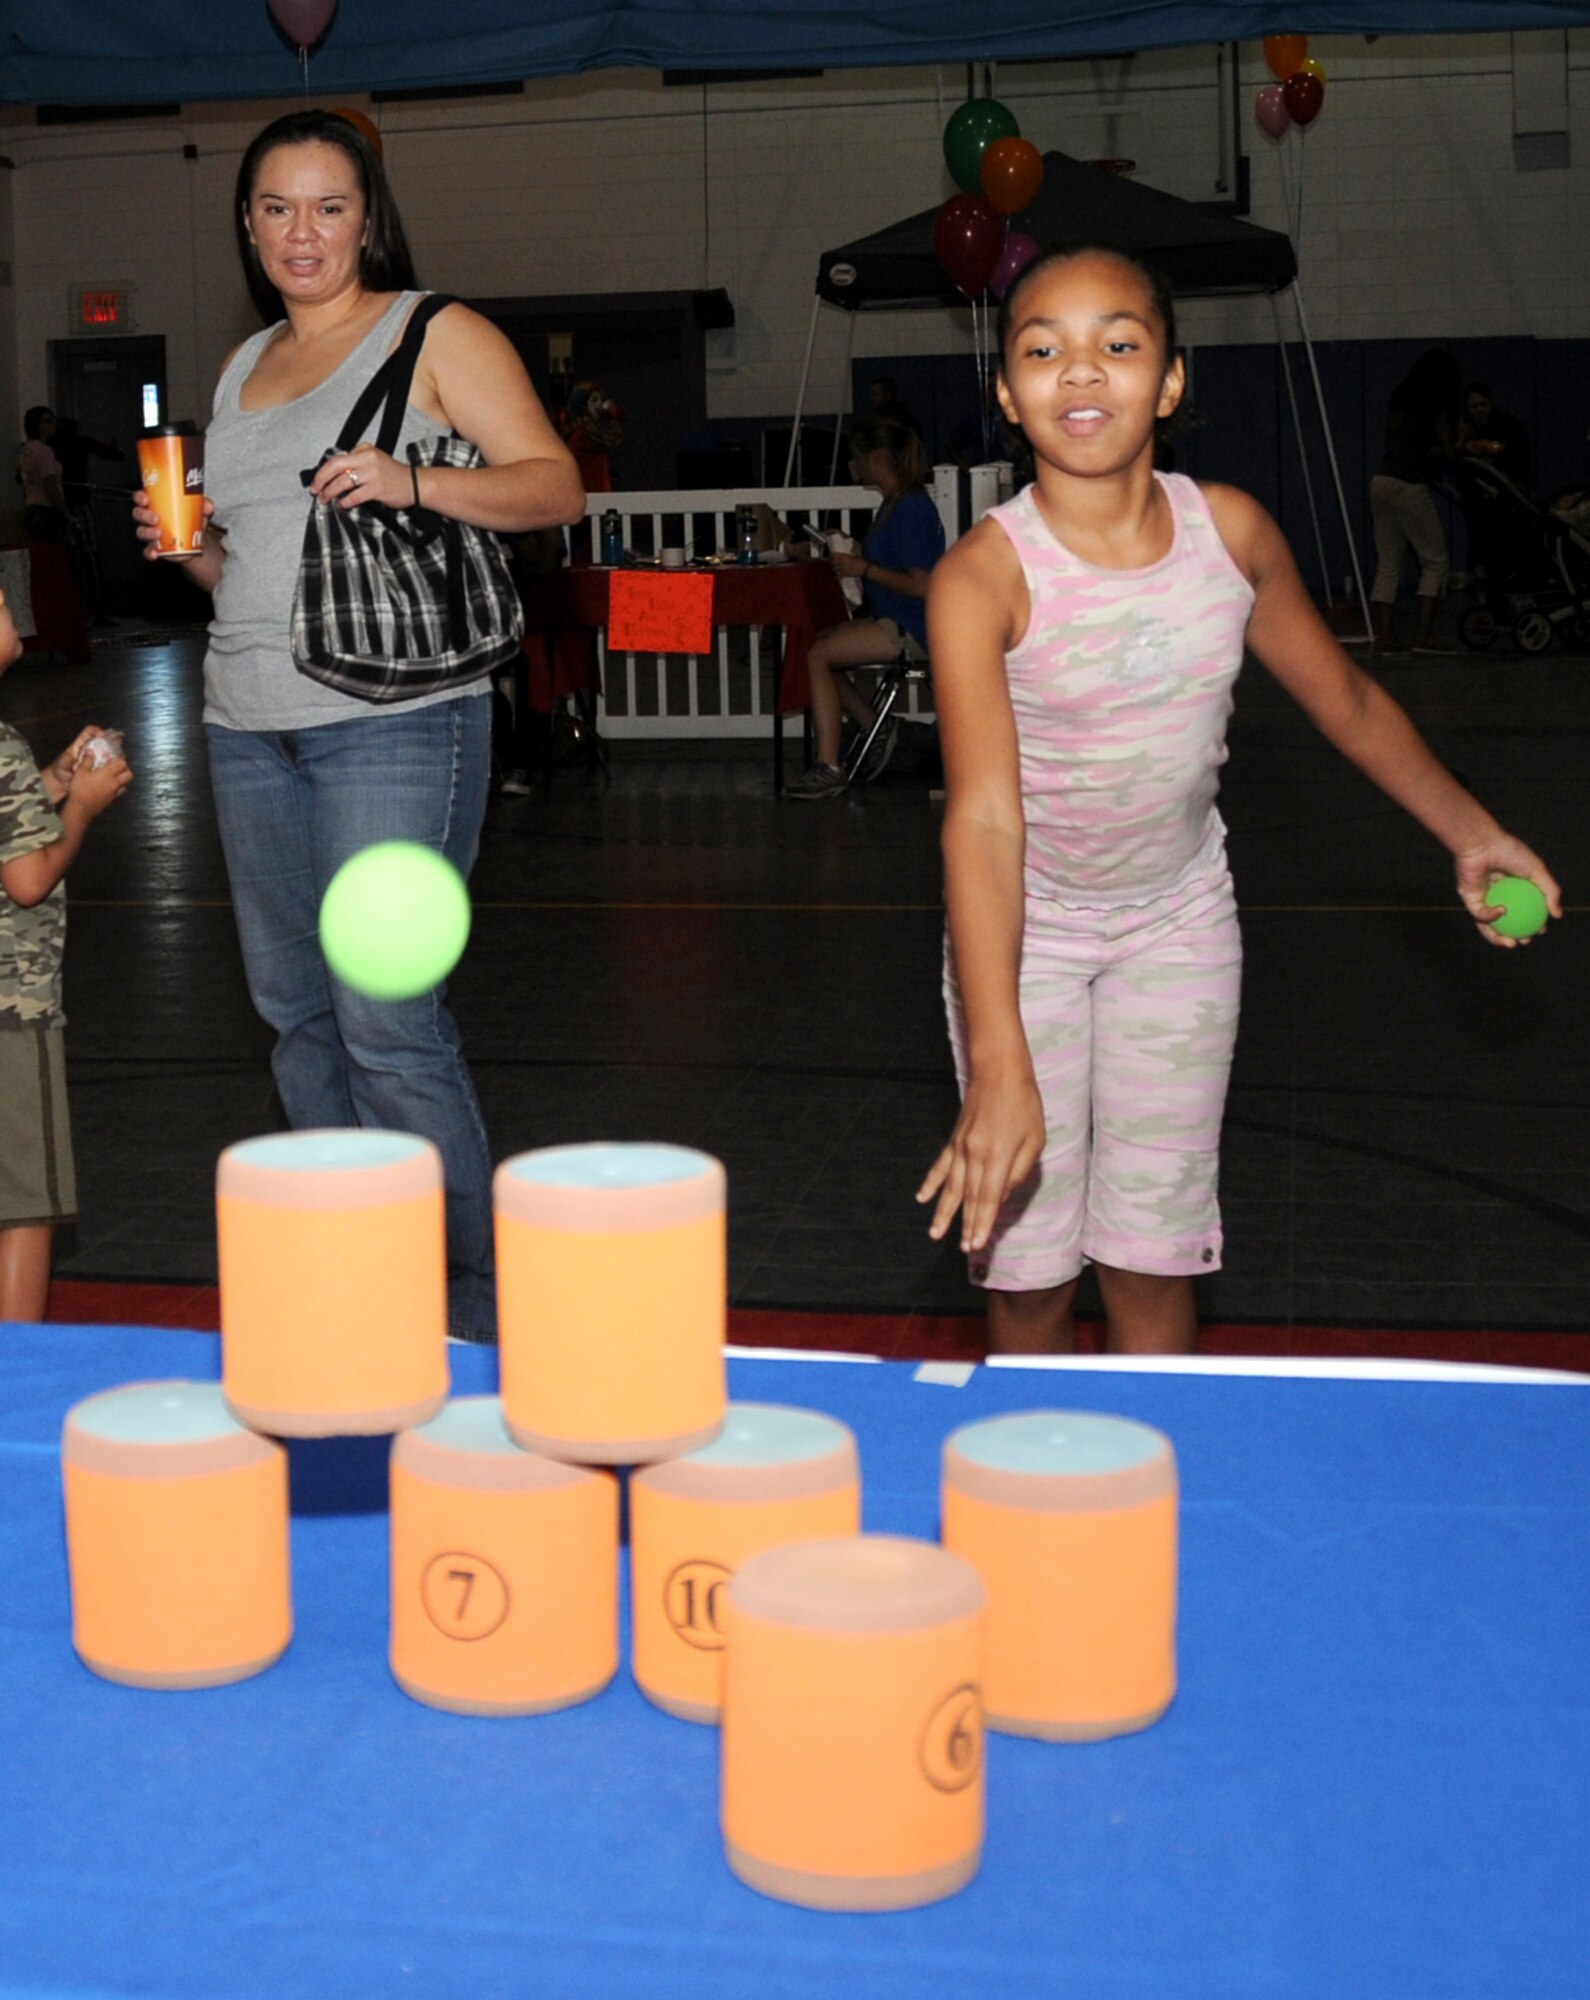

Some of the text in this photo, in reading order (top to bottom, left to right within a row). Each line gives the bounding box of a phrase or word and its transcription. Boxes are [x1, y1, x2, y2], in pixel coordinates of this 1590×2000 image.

[84, 293, 117, 322] EXIT
[447, 1569, 475, 1621] 7
[948, 1703, 976, 1771] 6
